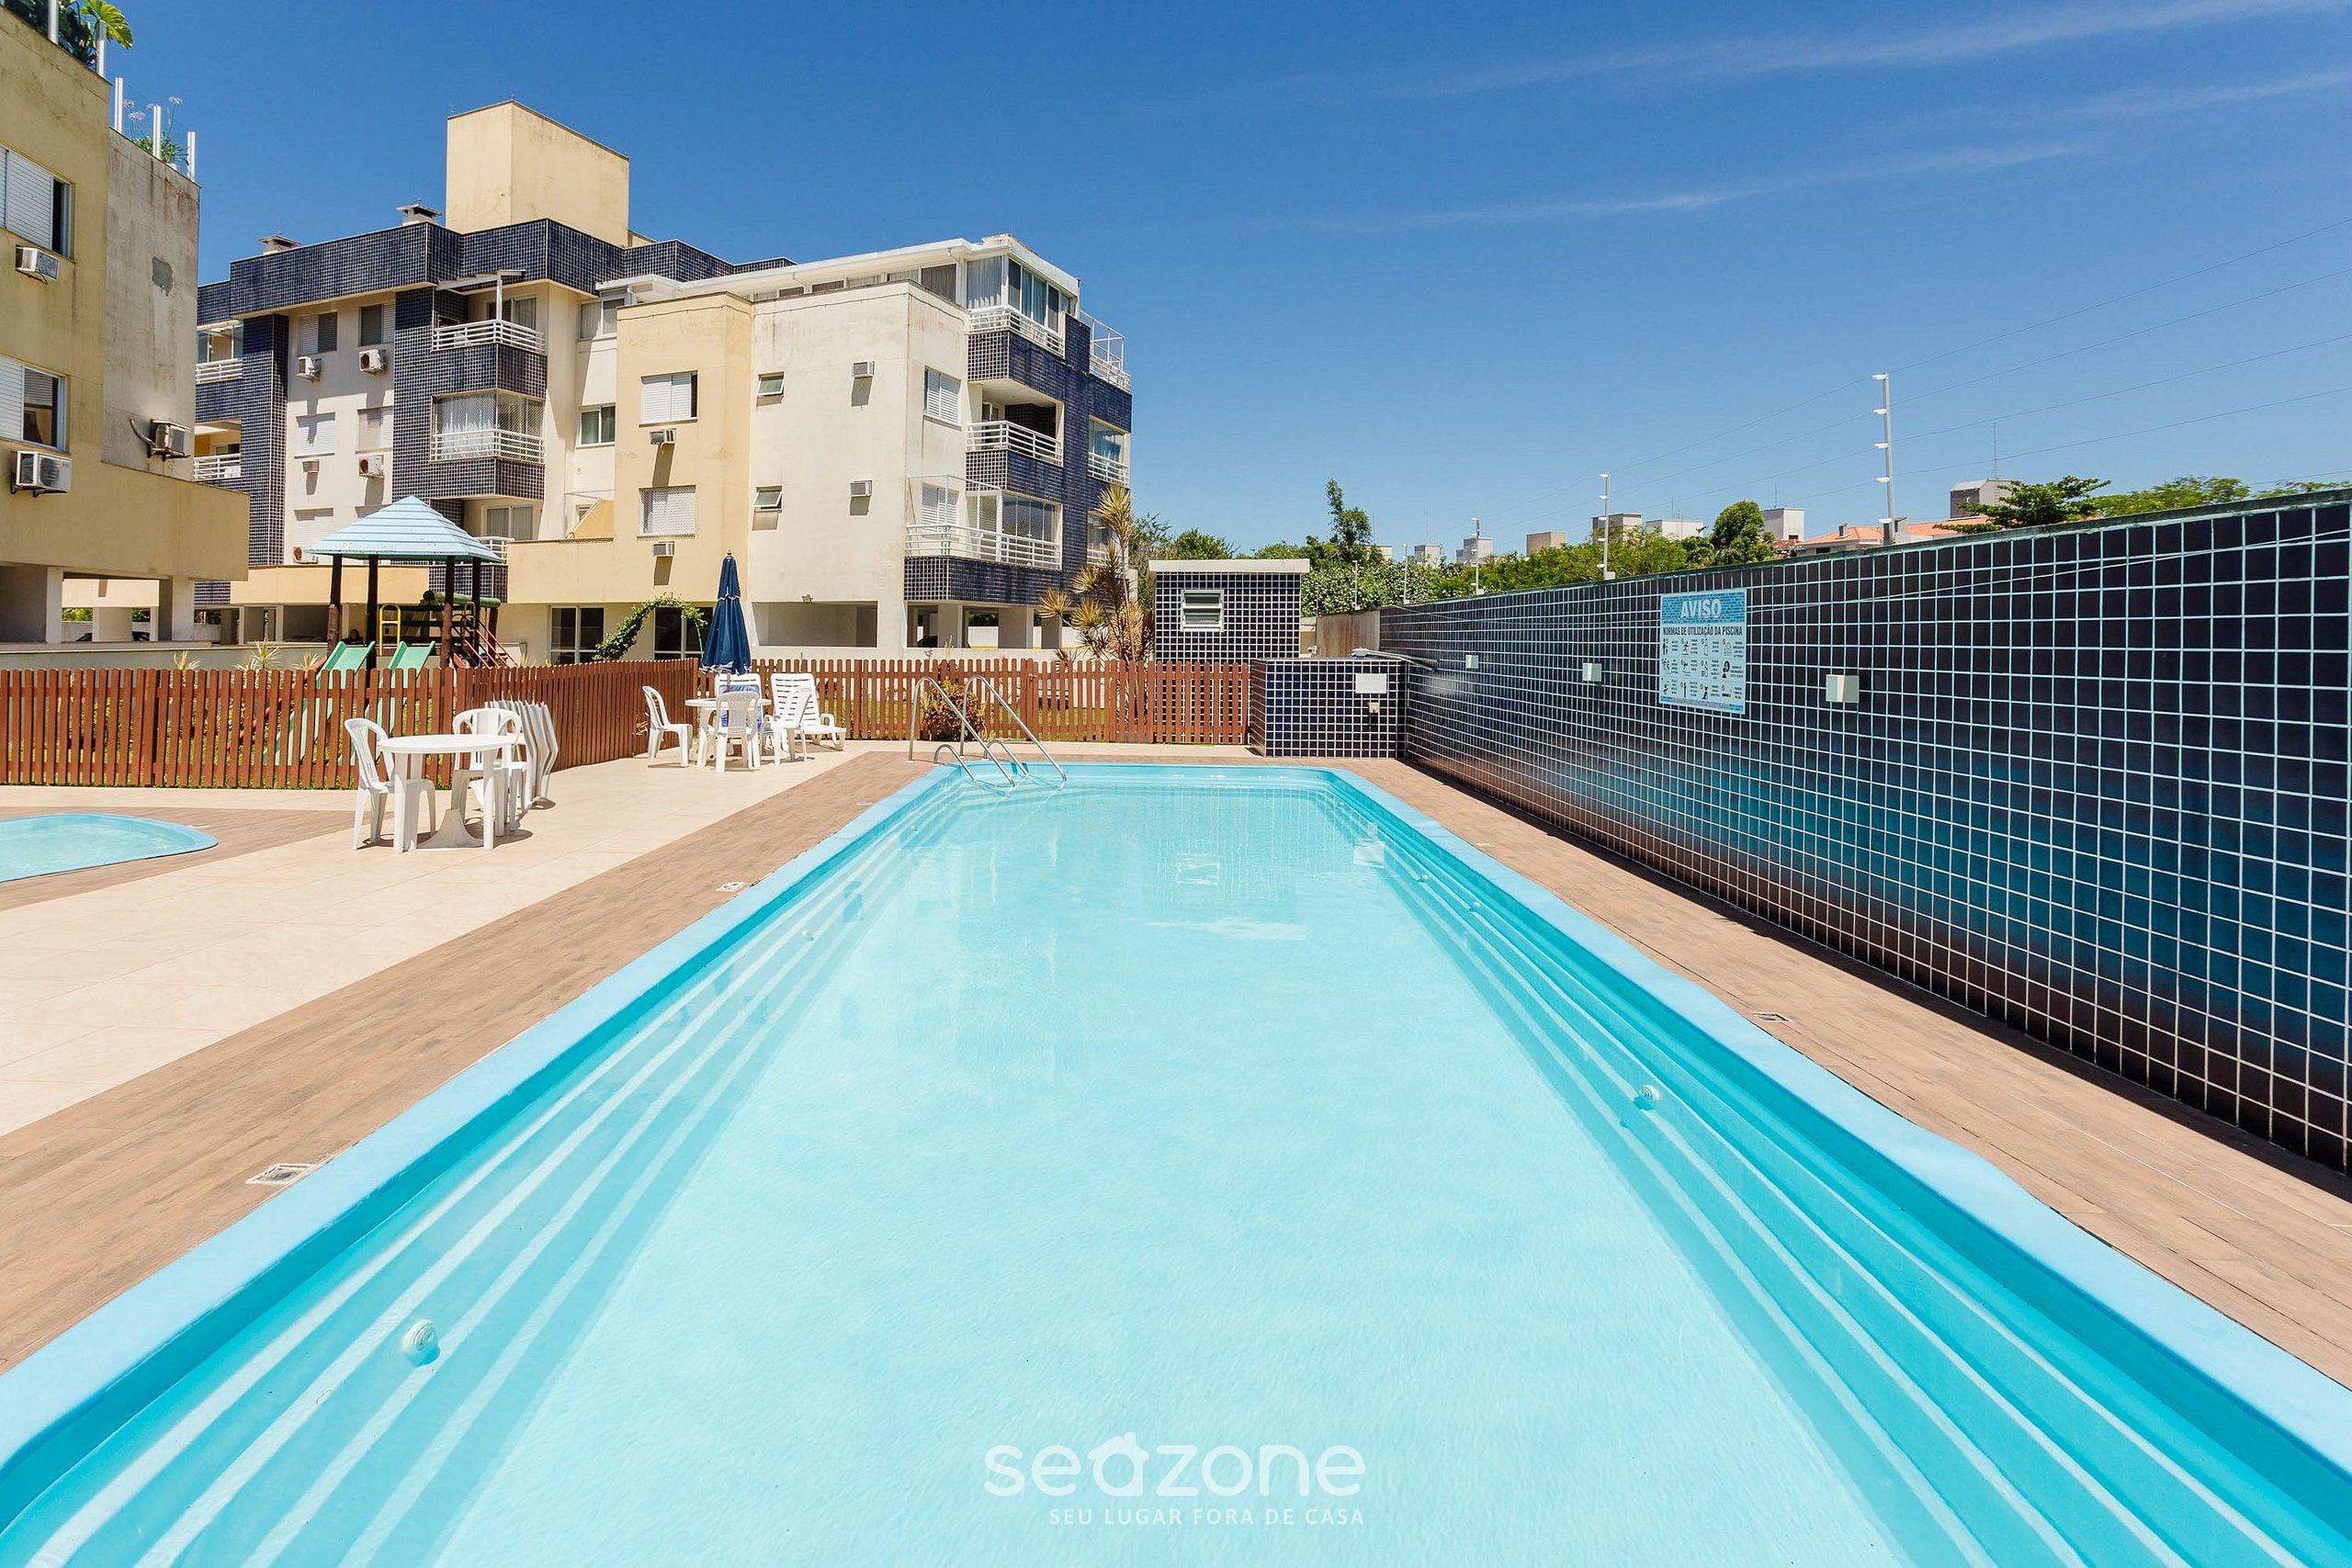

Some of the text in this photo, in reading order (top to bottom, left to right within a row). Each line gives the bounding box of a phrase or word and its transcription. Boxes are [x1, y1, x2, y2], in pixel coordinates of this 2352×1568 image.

[1680, 599, 1723, 619] AVISO
[1663, 625, 1742, 637] NORMAS DE UTILIZAÇÃO DA PISCINA
